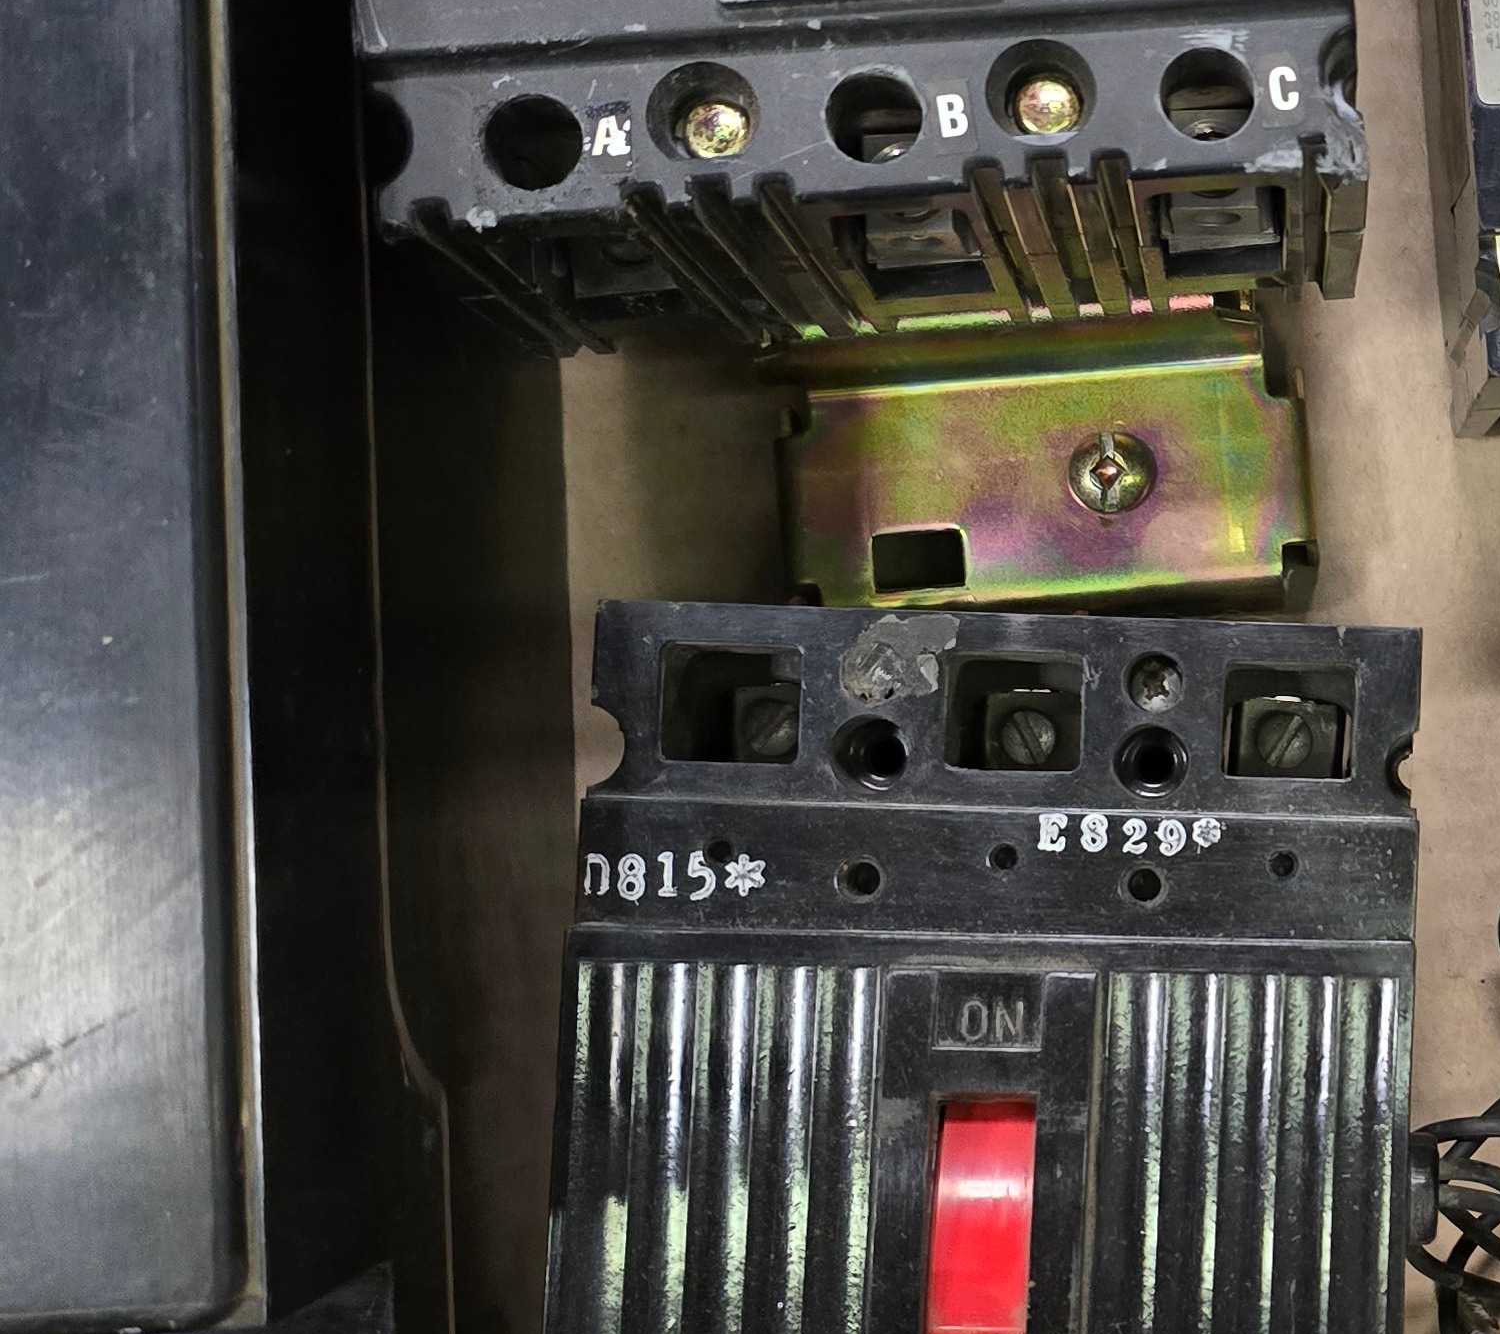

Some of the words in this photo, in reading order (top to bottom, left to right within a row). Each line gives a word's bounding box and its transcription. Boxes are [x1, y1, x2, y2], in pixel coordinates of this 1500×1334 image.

[1268, 66, 1300, 111] C
[592, 114, 630, 157] A
[936, 93, 968, 139] B
[960, 998, 1027, 1044] ON
